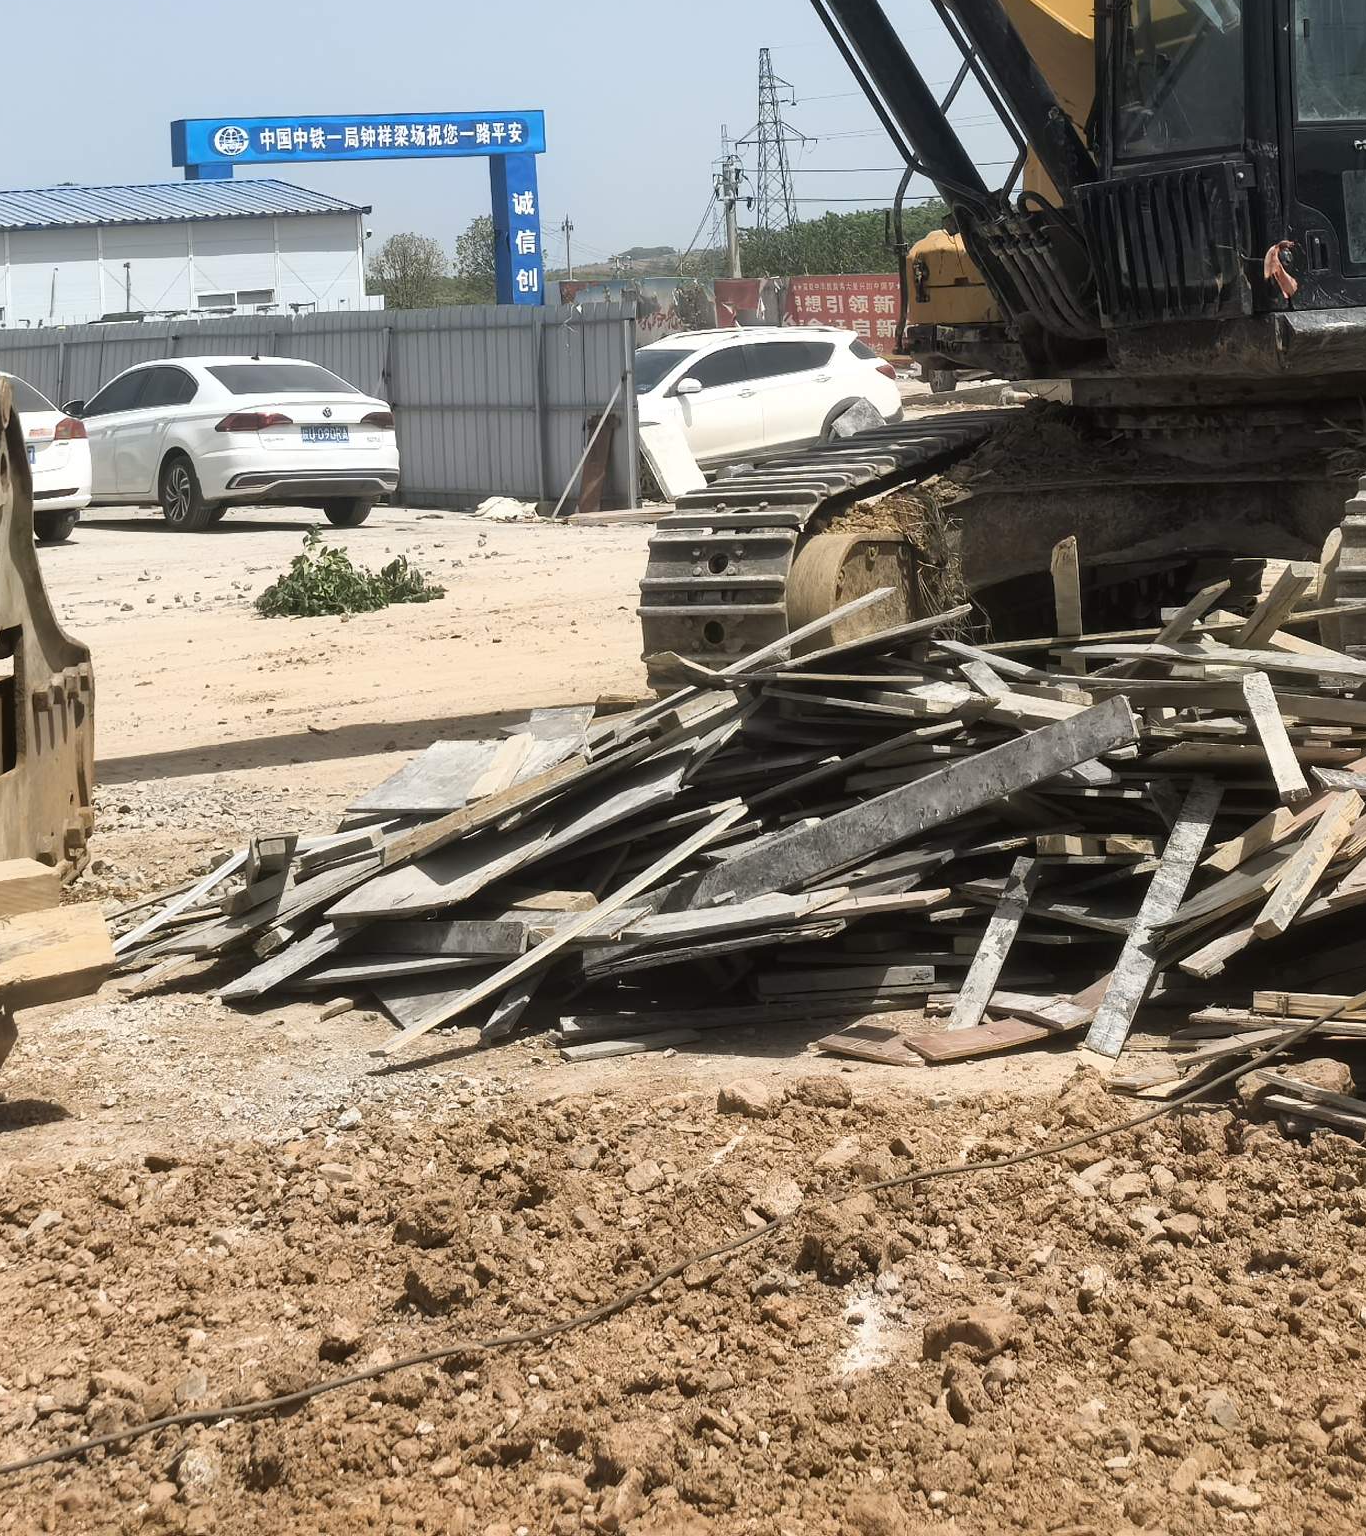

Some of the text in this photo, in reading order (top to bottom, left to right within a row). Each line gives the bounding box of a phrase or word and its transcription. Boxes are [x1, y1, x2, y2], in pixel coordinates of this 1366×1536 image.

[260, 122, 523, 151] 中国中铁一局钟祥梁场祝您一路平安
[512, 191, 538, 293] 诚信创
